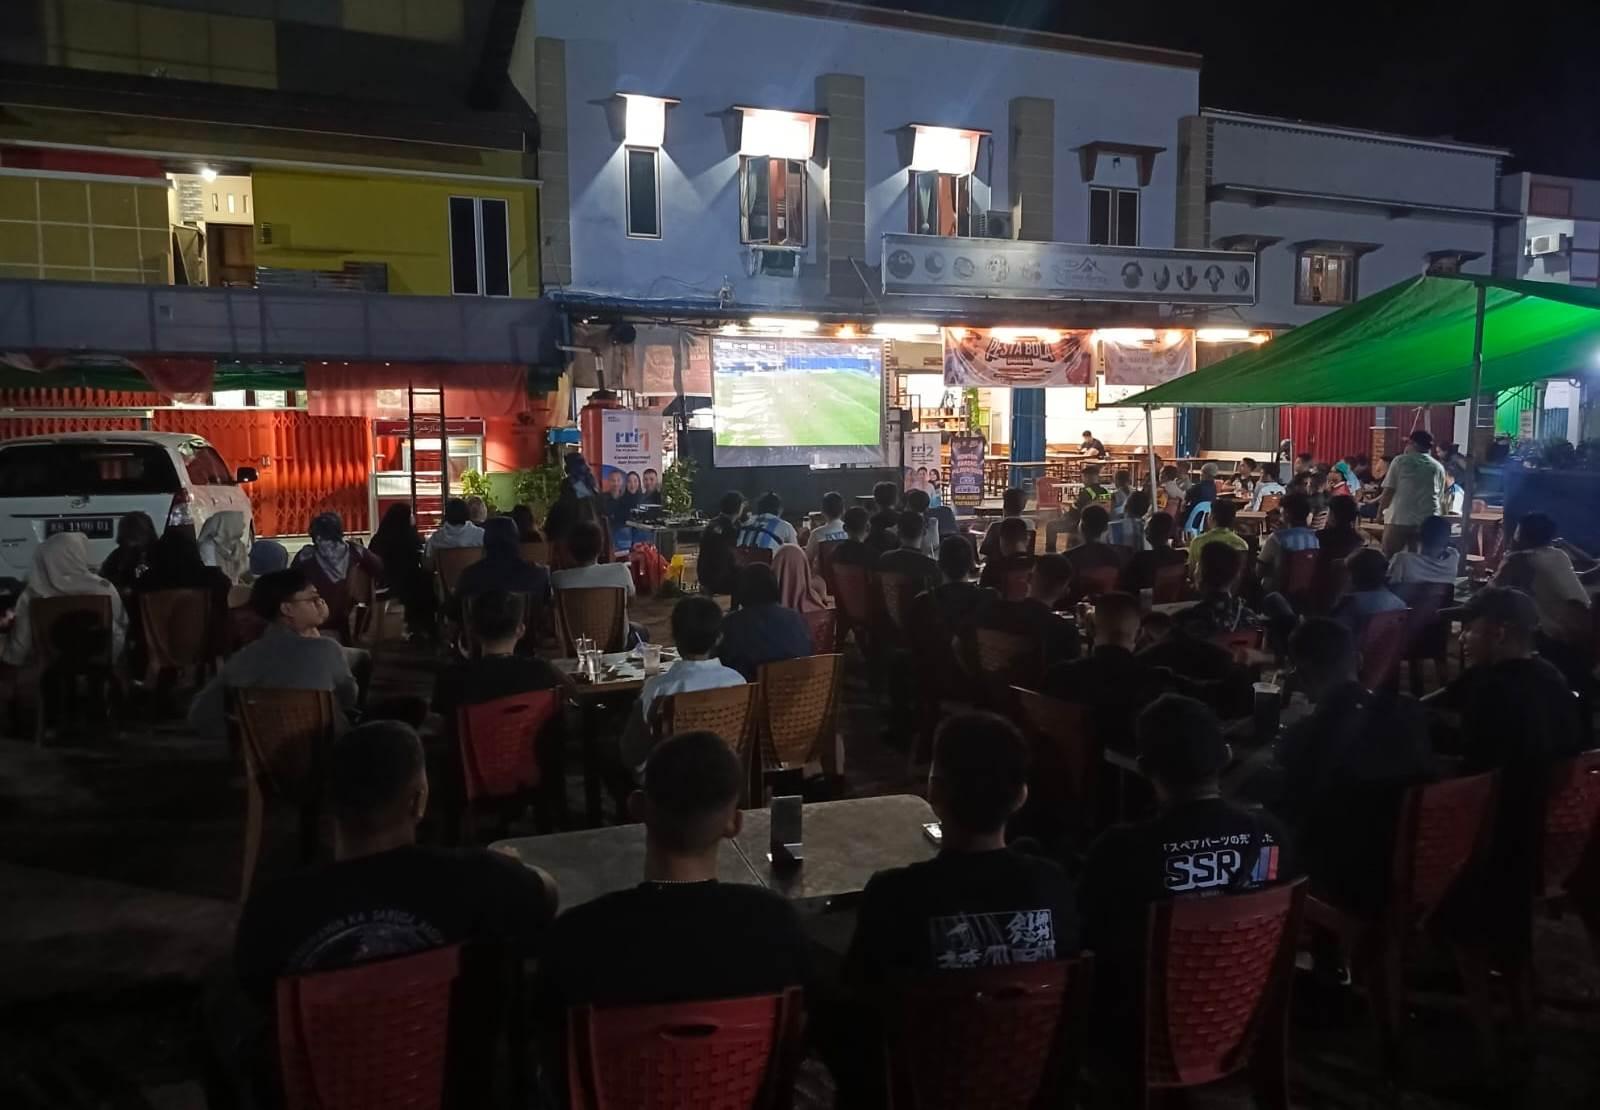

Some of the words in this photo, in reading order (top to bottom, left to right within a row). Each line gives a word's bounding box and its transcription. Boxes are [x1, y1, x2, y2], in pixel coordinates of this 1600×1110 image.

[985, 337, 1021, 361] PESTA
[1024, 340, 1056, 362] BOLA
[615, 428, 638, 443] rri
[927, 446, 934, 458] 2
[1165, 849, 1240, 890] SSR
